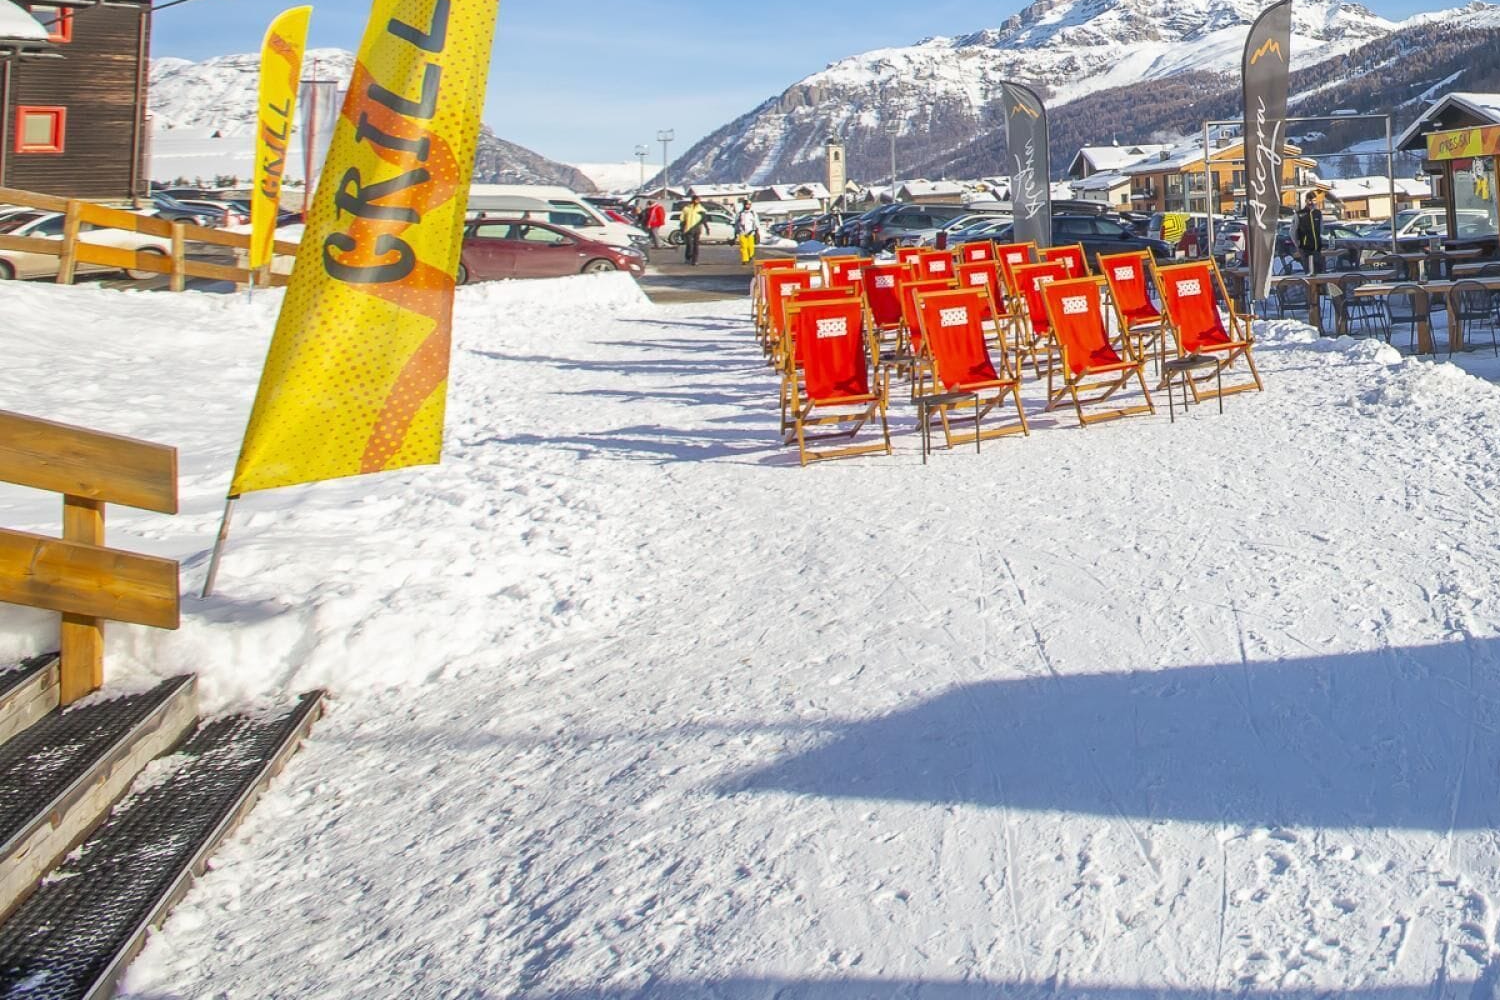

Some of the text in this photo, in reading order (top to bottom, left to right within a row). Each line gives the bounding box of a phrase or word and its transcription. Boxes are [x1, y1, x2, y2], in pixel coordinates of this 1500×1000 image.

[261, 99, 290, 198] GRILL
[1249, 95, 1282, 230] Alegra
[1177, 281, 1201, 293] 3000
[1063, 298, 1088, 310] 3000
[941, 310, 968, 323] 3000
[817, 320, 848, 333] 3000
